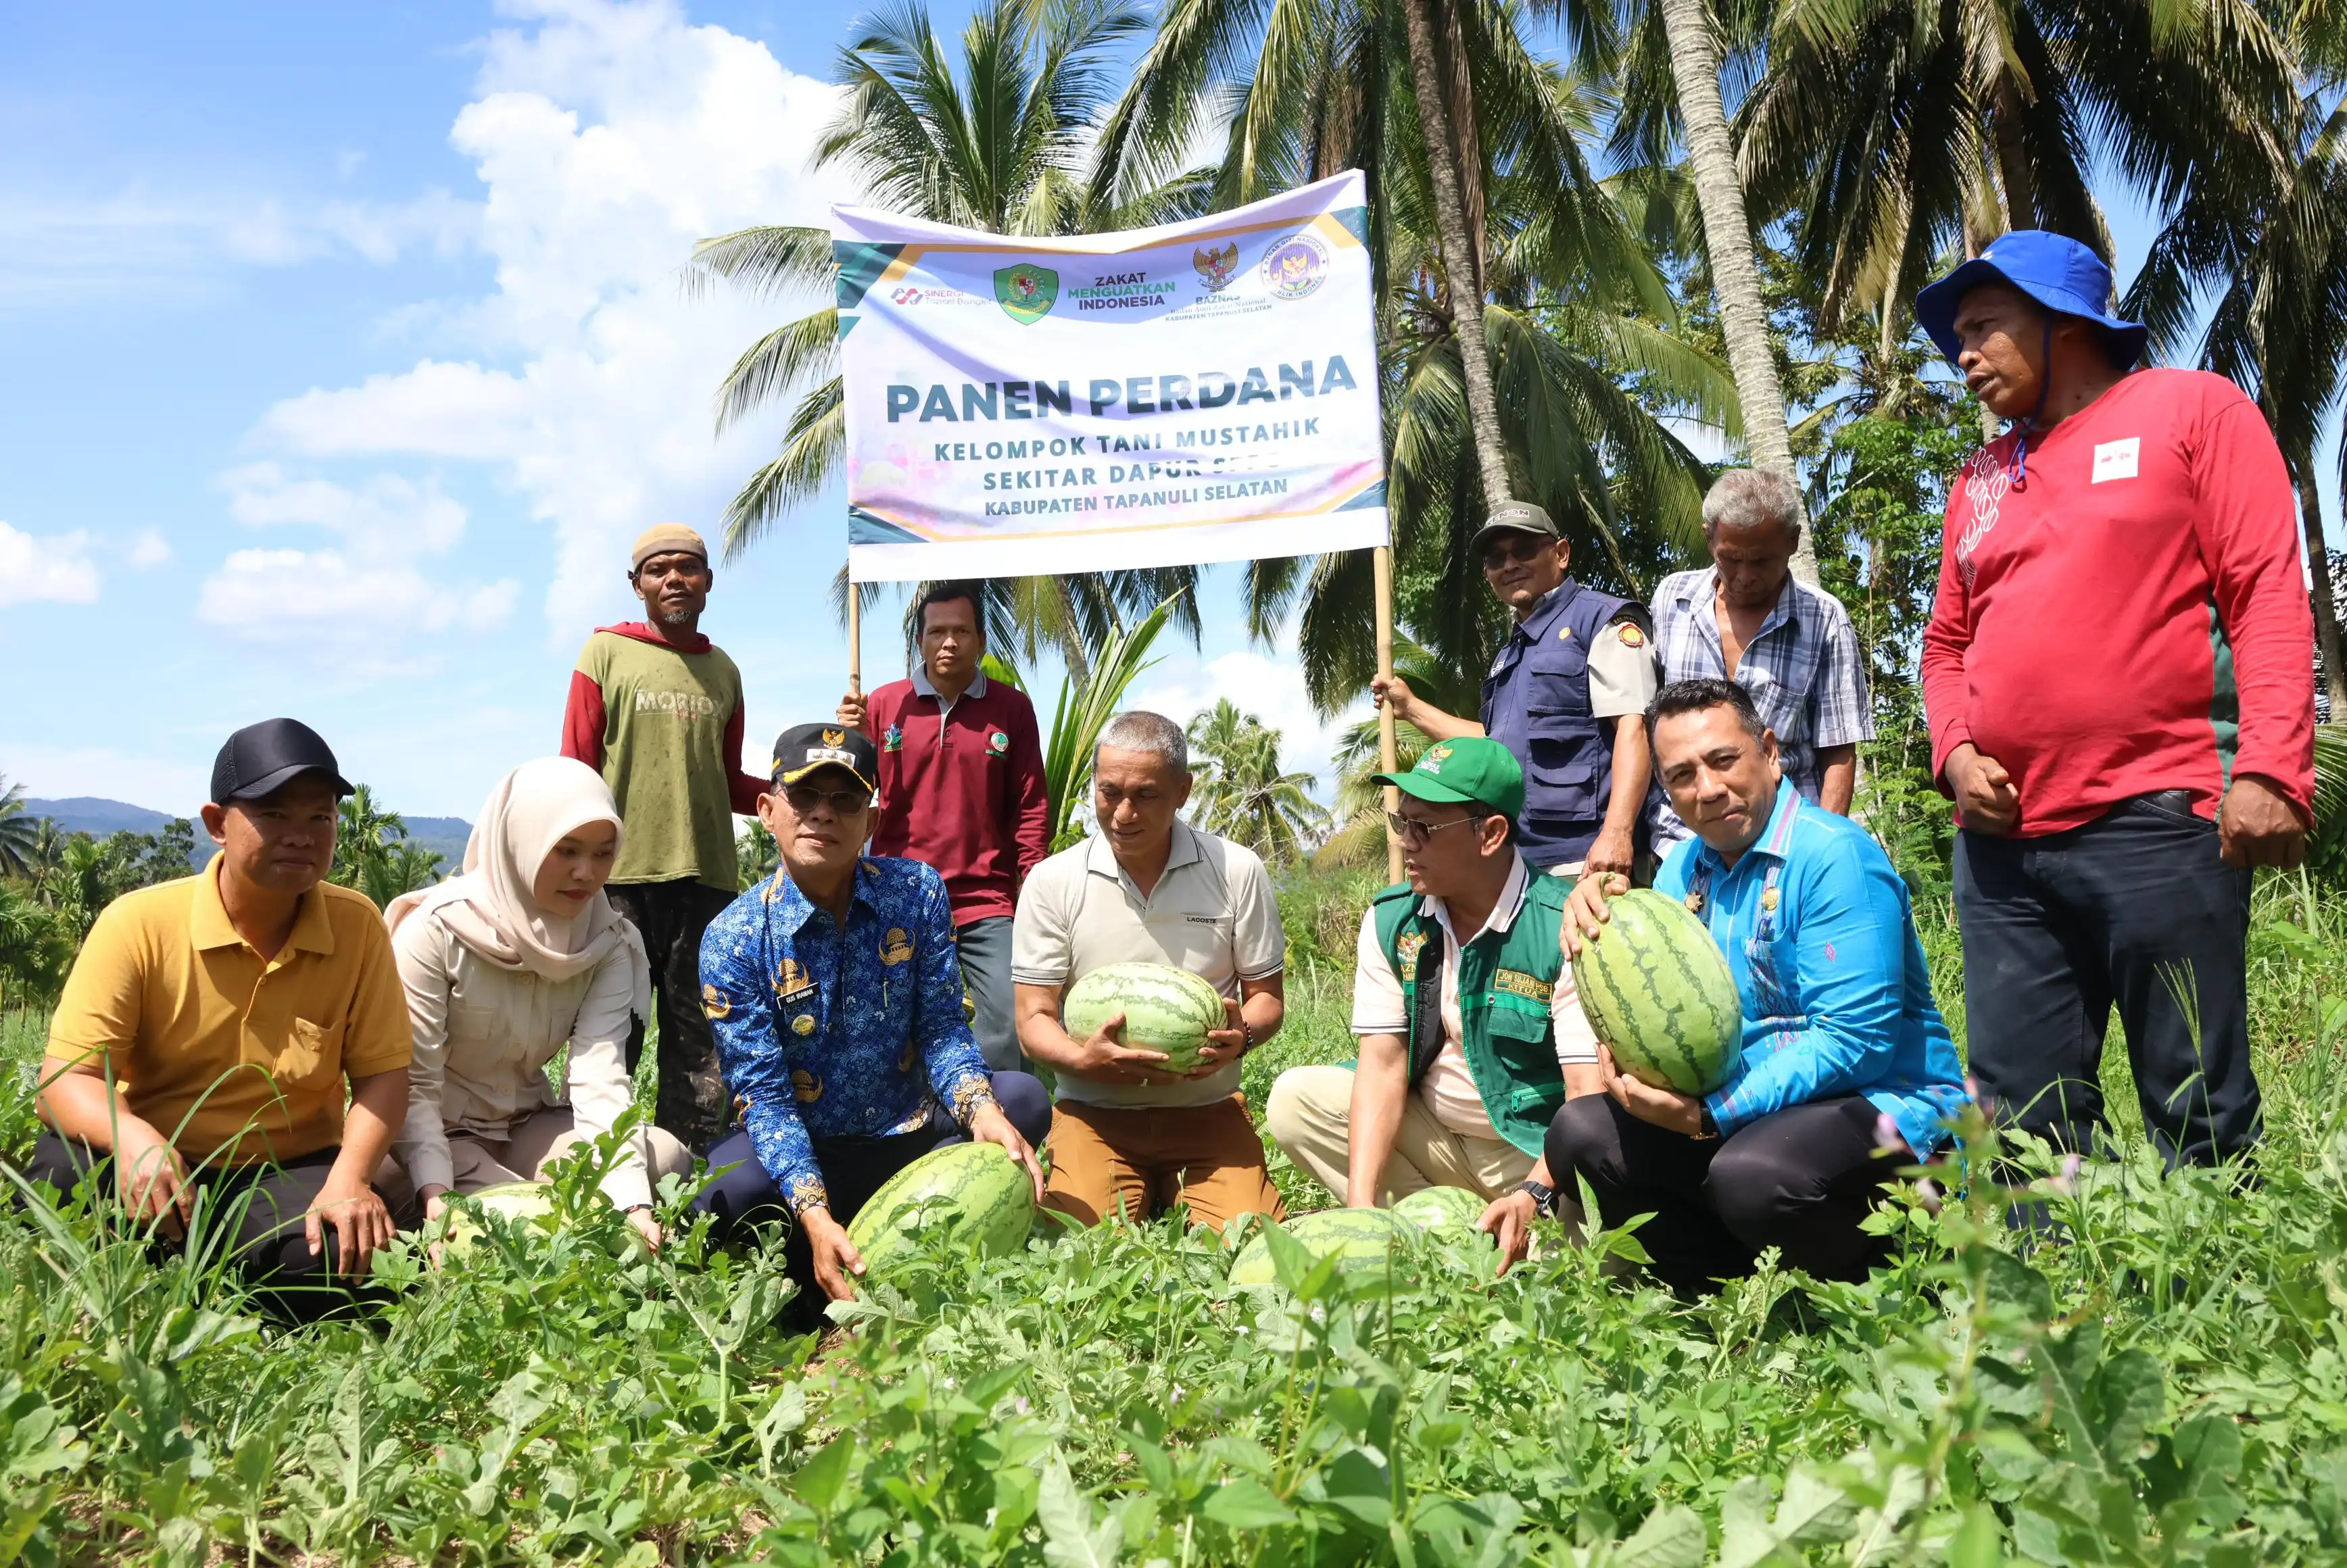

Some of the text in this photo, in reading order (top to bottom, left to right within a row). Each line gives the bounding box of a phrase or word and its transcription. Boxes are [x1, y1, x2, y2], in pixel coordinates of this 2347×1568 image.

[1095, 272, 1146, 287] ZAKAT
[925, 289, 964, 298] SINERGI
[1068, 281, 1176, 299] MENGUATKAN
[1079, 295, 1165, 310] INDONESIA
[1165, 304, 1273, 322] KABUPATEN TAPANULI SELATAN
[887, 355, 1357, 422] PANEN PERDANA
[935, 417, 1320, 461] KELOMPOK TANI MUSTAHIK
[984, 467, 1098, 490] SEKITAR
[1109, 460, 1202, 483] DAPUR
[985, 479, 1287, 516] KABUPATEN TAPANULI SELATAN
[1500, 972, 1513, 981] JON
[785, 989, 814, 1004] GUS IRAWAN
[1508, 983, 1538, 998] KETUA
